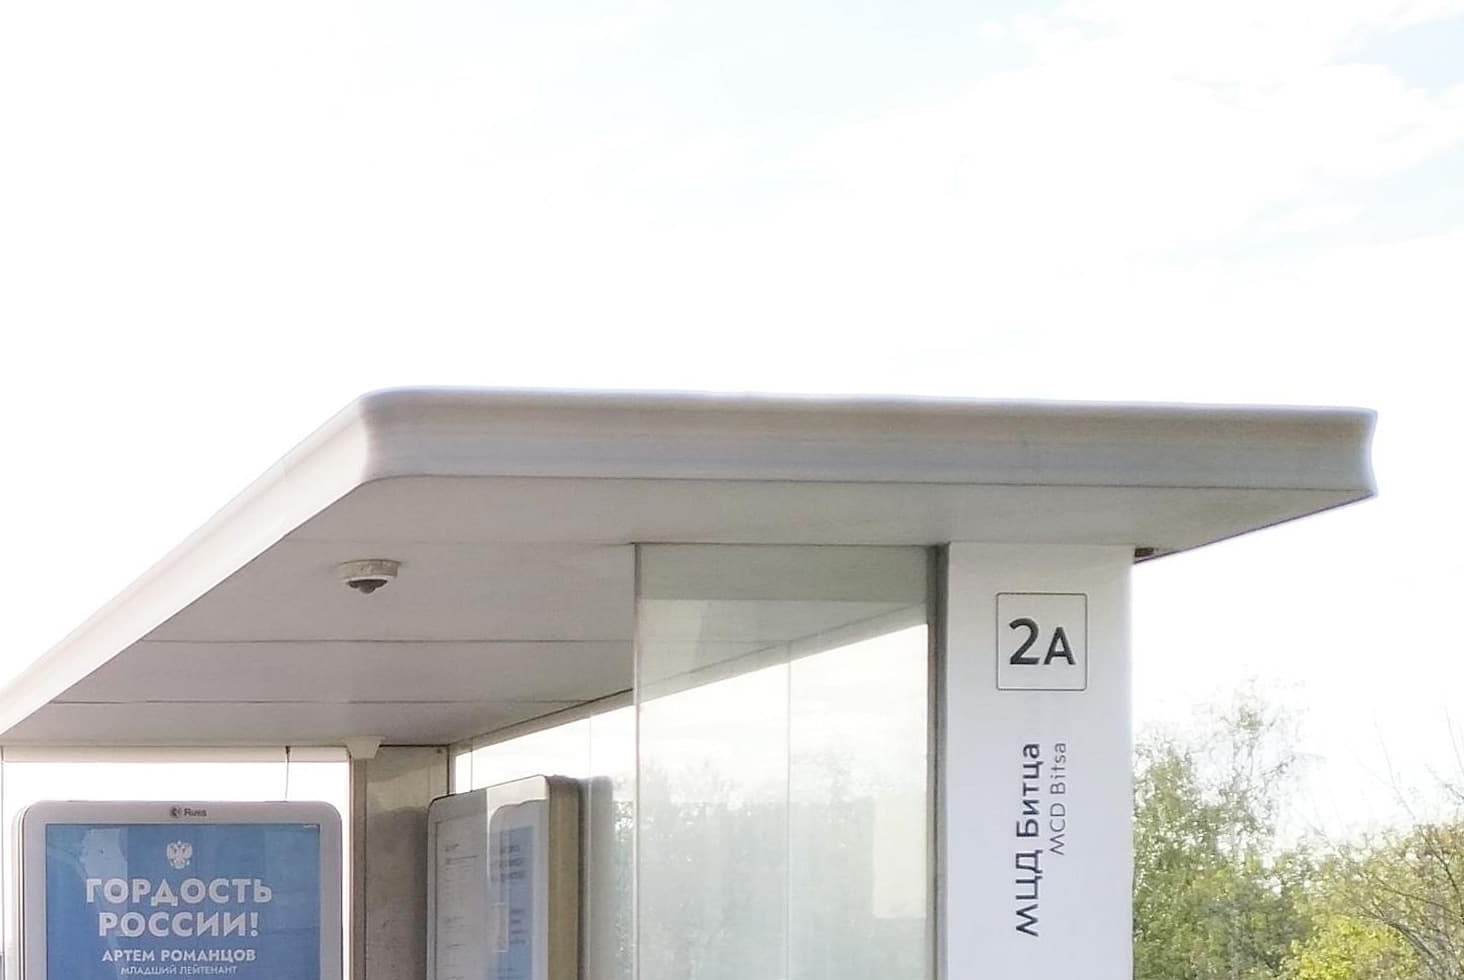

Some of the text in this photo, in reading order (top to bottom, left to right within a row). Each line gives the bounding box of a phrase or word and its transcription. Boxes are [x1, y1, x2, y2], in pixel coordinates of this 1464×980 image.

[1049, 743, 1066, 856] MCD Bitsa
[1016, 743, 1044, 937] МЦД Битца
[86, 878, 273, 906] ГОРДОСТЬ
[99, 911, 259, 937] РОССИИ!
[102, 950, 256, 963] АРТЕМ РОМАНЦОВ
[121, 964, 237, 975] МЛАДШИЙ ЛЕЙТЕНАНТ
